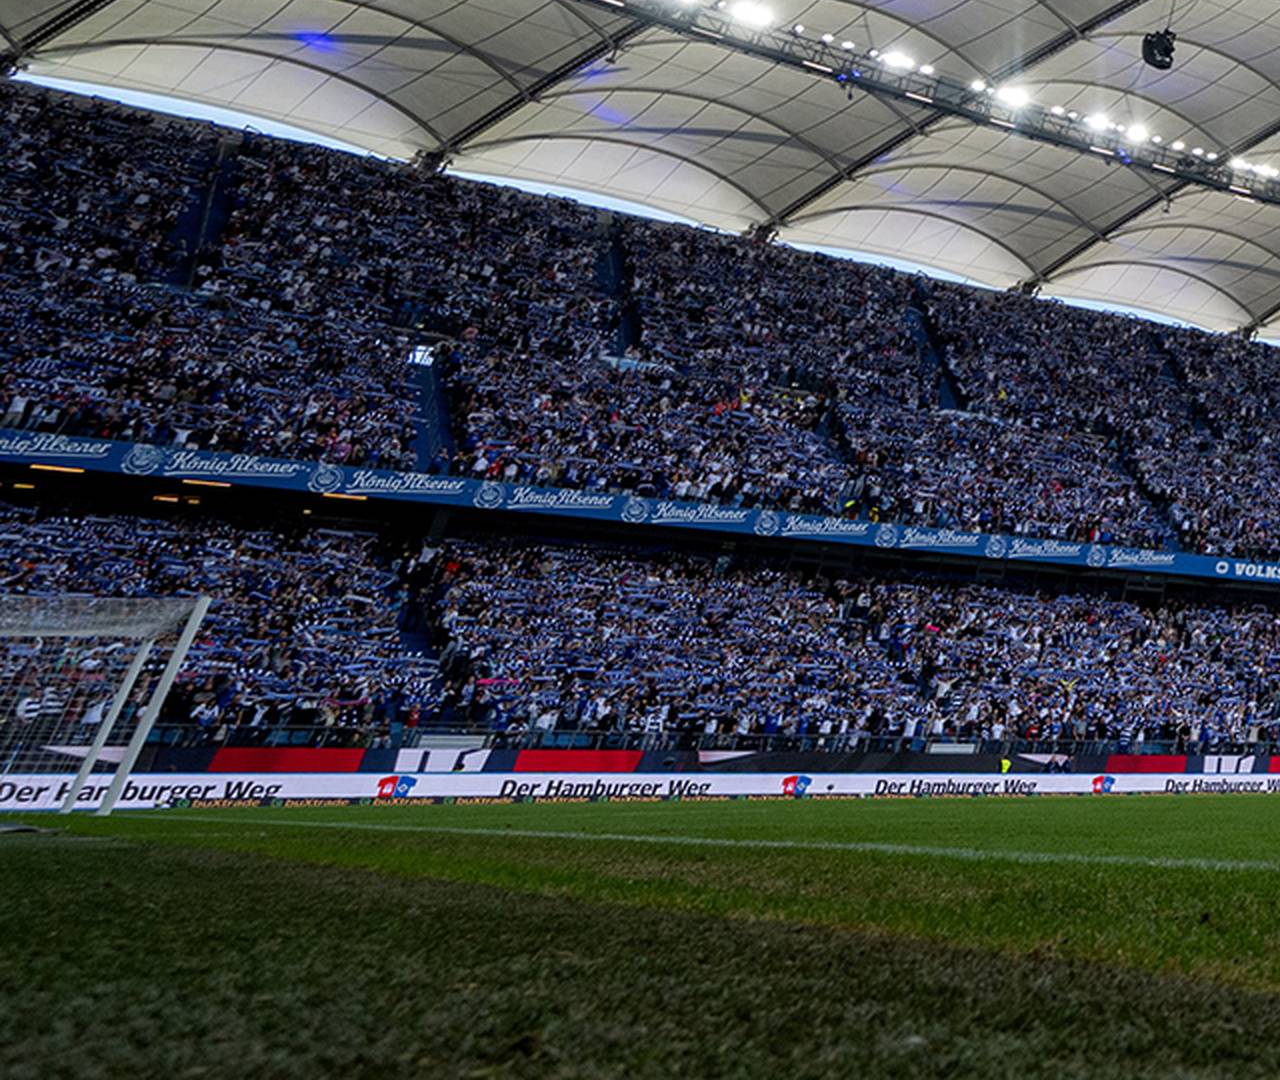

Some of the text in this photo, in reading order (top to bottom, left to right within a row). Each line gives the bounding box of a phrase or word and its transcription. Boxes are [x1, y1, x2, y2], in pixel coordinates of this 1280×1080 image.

[225, 781, 282, 800] Weg
[500, 779, 711, 797] Der Hamburger Weg
[875, 779, 1037, 794] Der Hamburger Weg
[1165, 779, 1190, 792] Der
[1192, 779, 1263, 792] Hamburger
